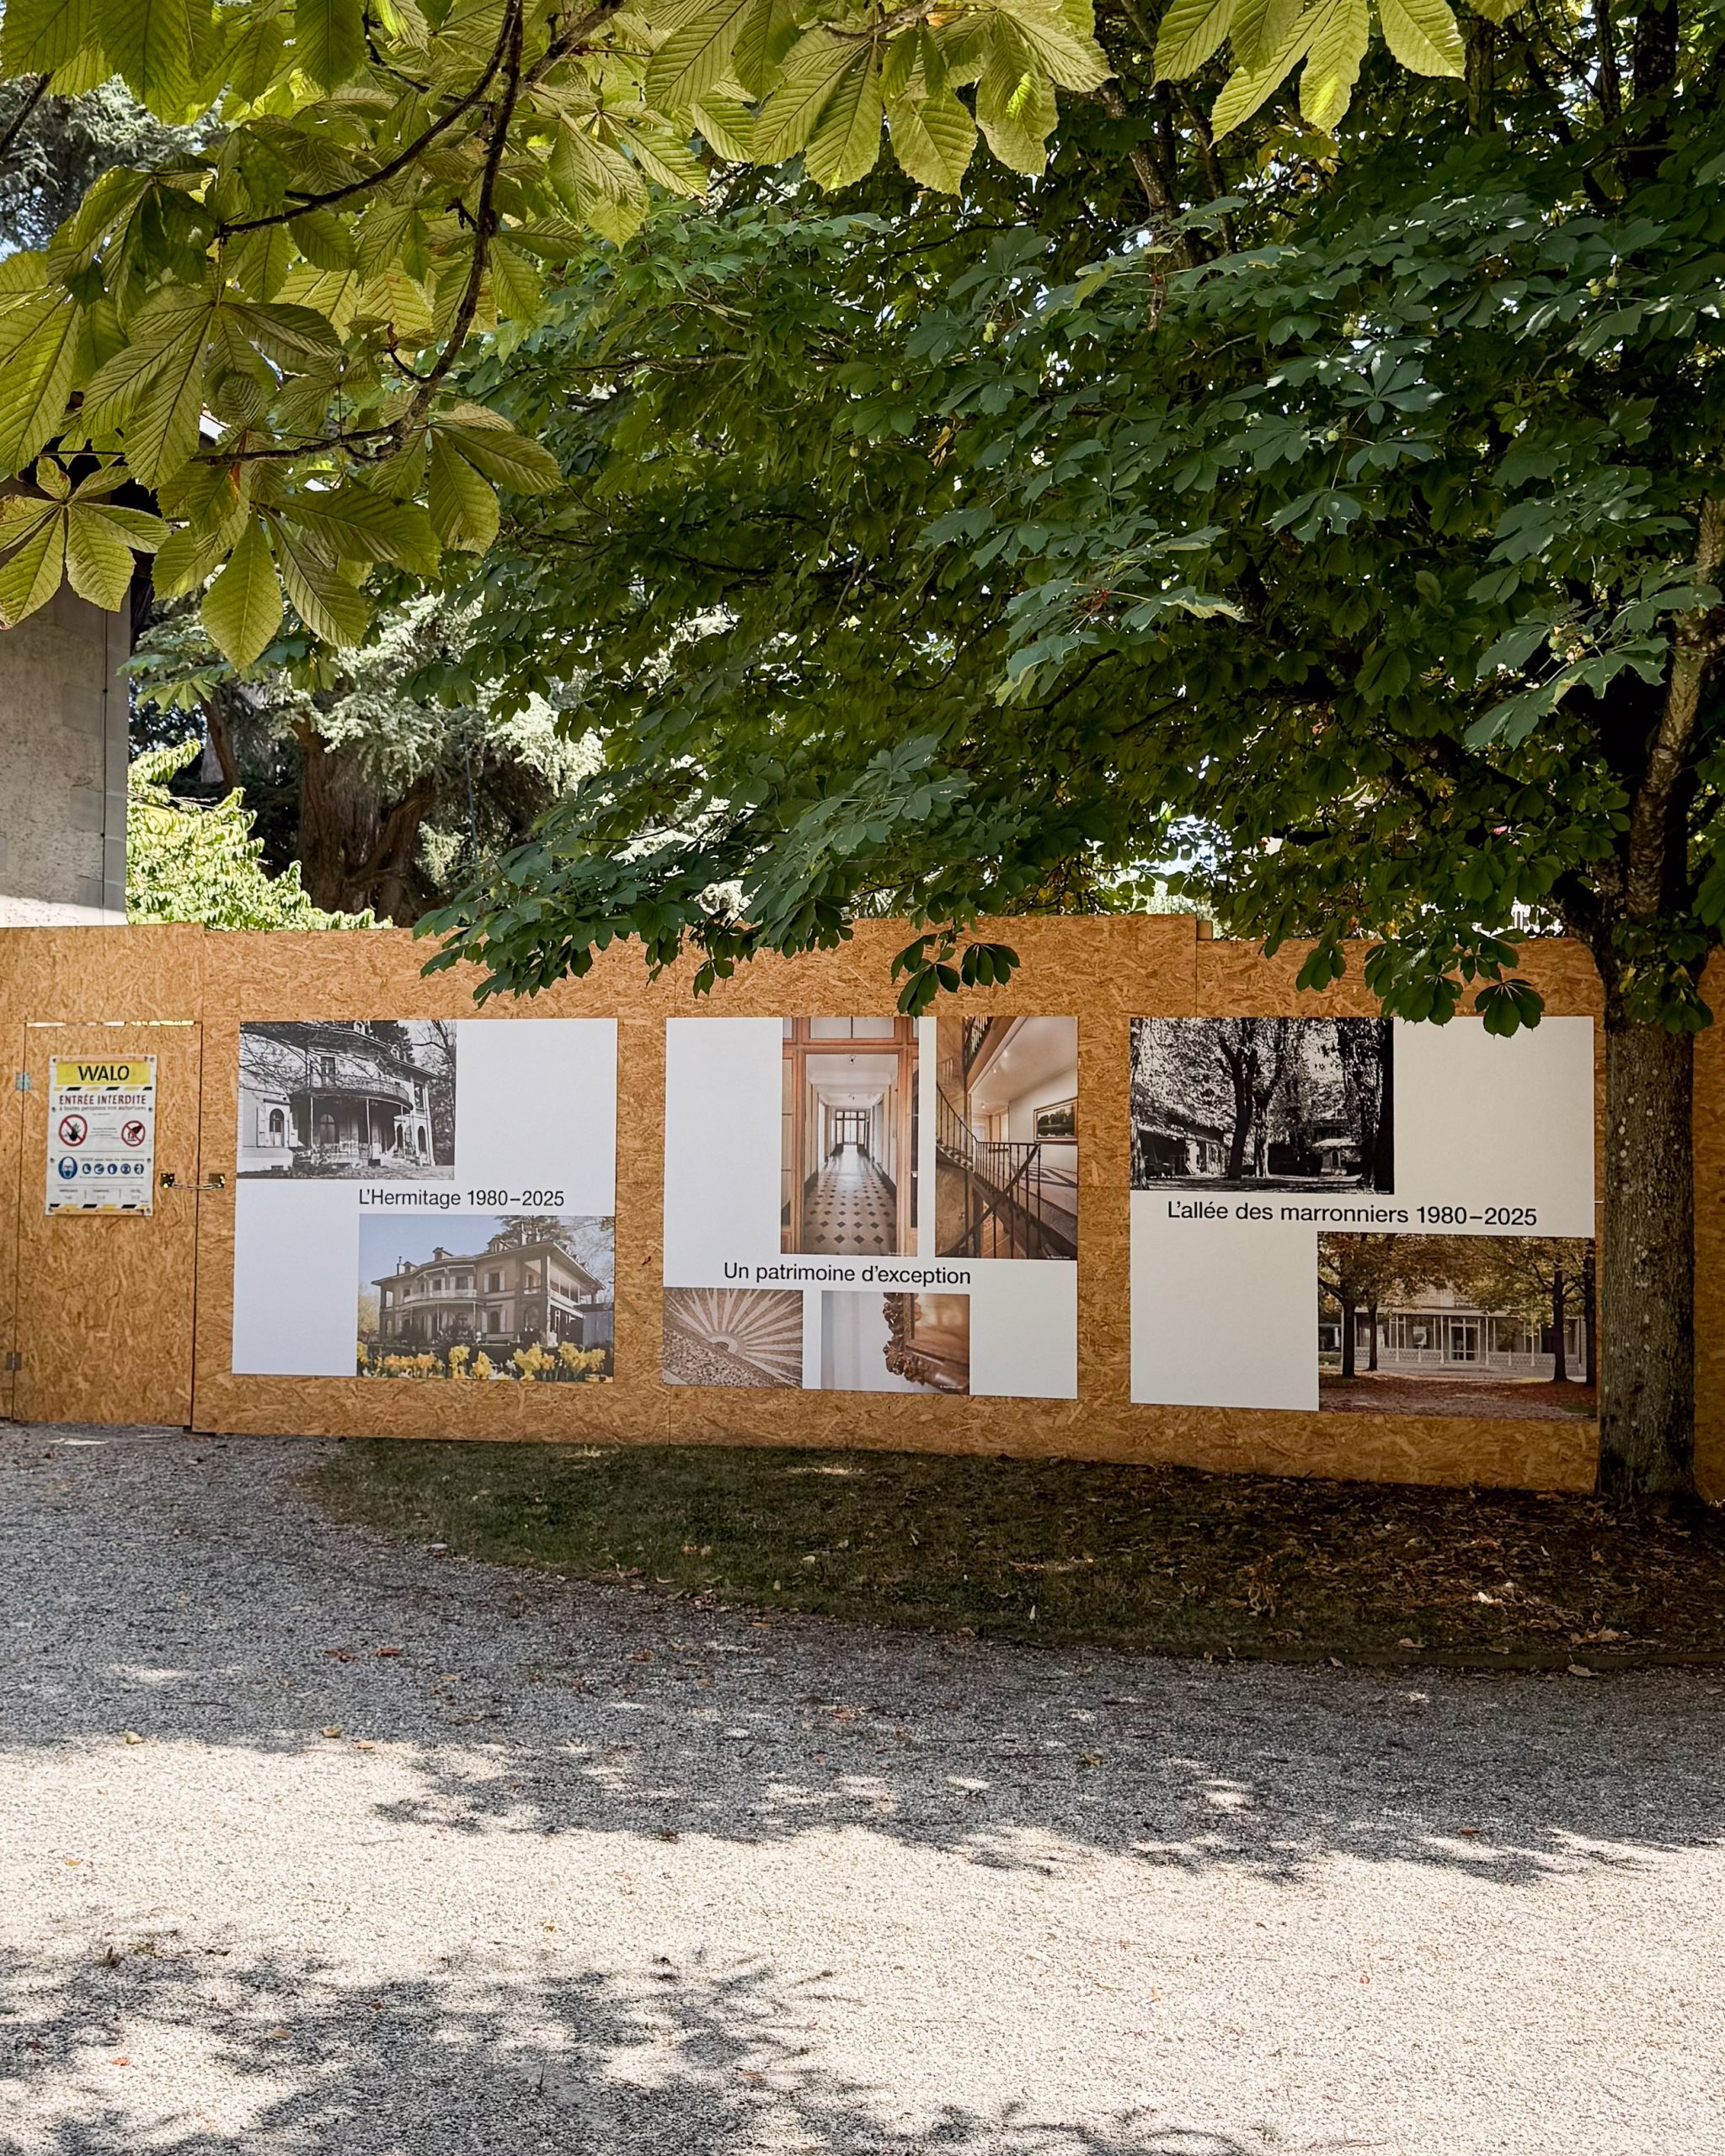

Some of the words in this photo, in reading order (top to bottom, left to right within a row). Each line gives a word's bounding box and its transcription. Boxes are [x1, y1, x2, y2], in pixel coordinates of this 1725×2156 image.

[77, 1065, 130, 1081] WALO
[59, 1094, 94, 1106] ENTRÉE
[98, 1095, 147, 1105] INTERDITE
[359, 1188, 461, 1209] L’Hermitage
[467, 1189, 564, 1207] 1980–2025
[1167, 1201, 1228, 1219] L’allée
[1236, 1203, 1274, 1220] des
[1280, 1204, 1408, 1223] marronniers
[1417, 1206, 1537, 1226] 1980–2025
[724, 1262, 749, 1279] Un
[756, 1263, 855, 1283] patrimoine
[862, 1265, 970, 1287] d’exception
